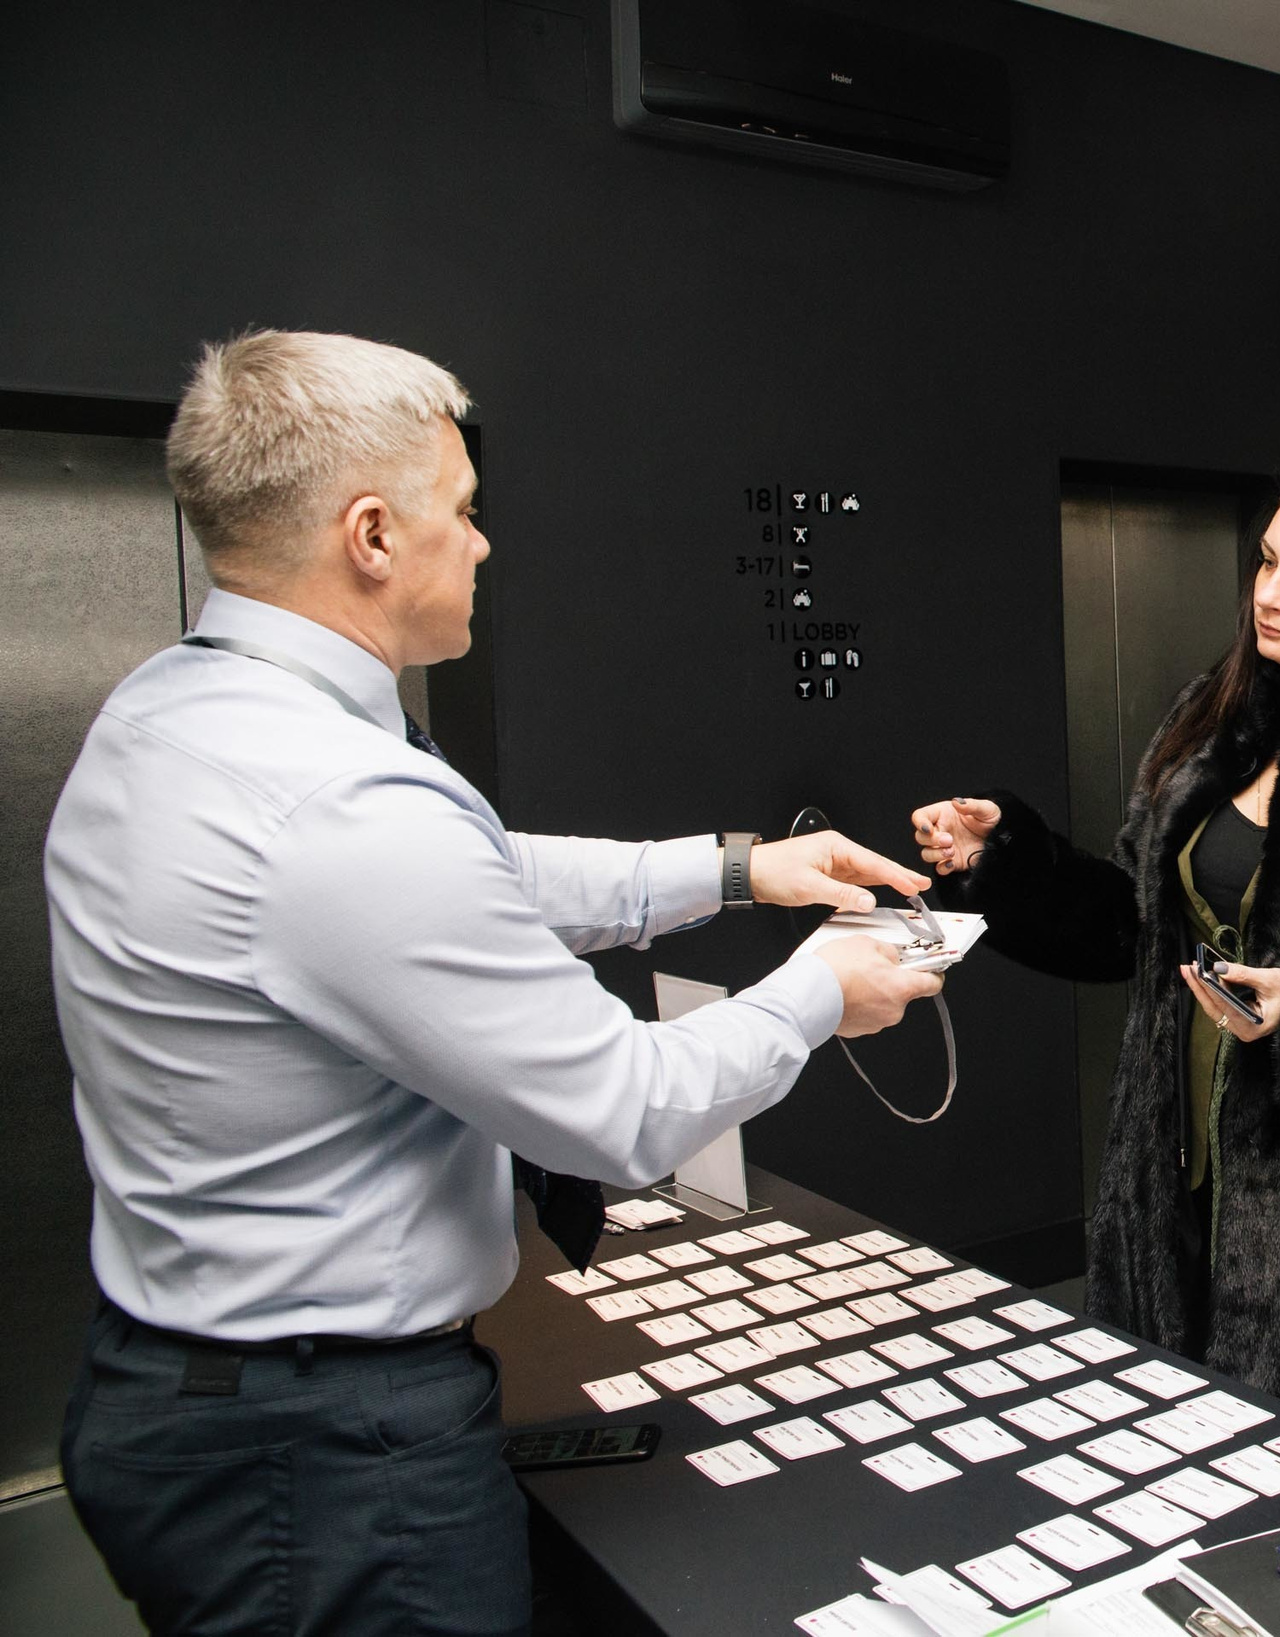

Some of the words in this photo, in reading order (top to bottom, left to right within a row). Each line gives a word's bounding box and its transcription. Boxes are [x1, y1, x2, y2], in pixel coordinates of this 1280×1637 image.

[831, 72, 852, 85] Haier
[743, 487, 772, 512] 18
[762, 524, 774, 543] 8
[735, 556, 775, 575] 3-17
[764, 589, 776, 608] 2
[766, 623, 774, 641] 1
[792, 622, 861, 641] LOBBY
